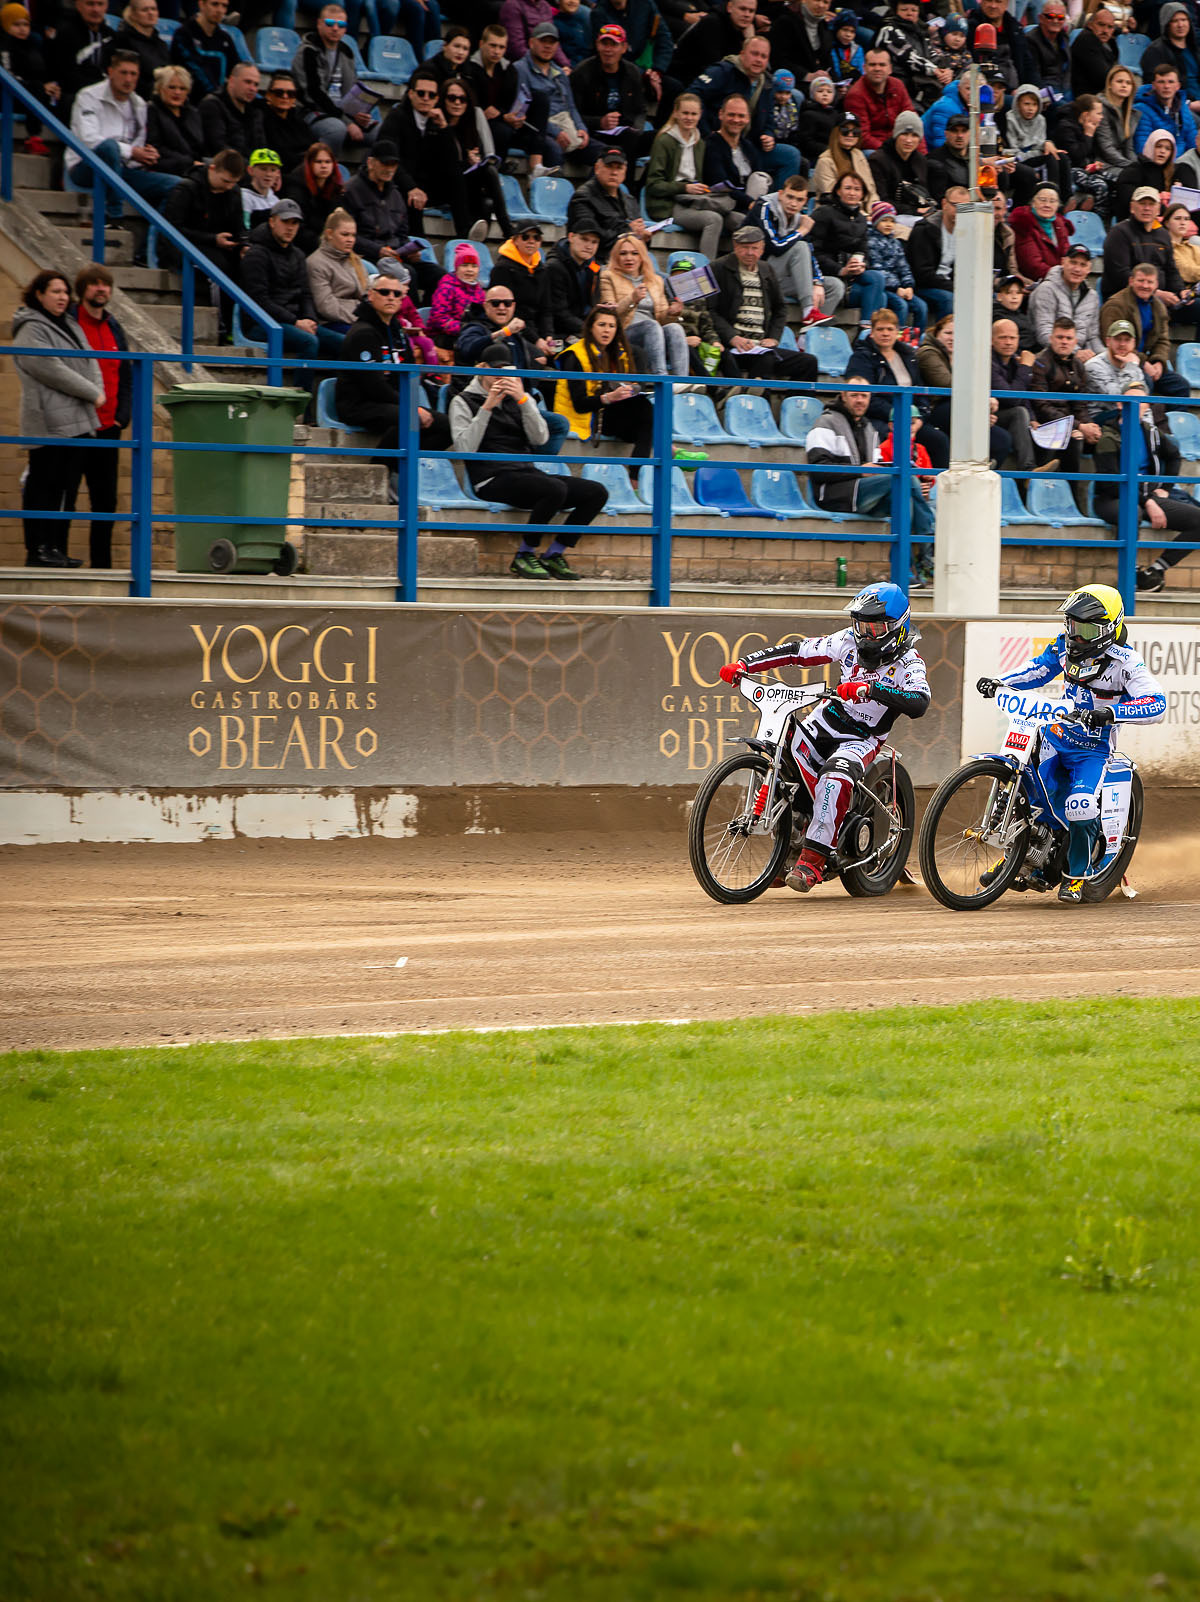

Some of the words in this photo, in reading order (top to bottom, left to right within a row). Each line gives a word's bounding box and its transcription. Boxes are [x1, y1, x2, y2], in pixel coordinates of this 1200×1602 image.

[189, 624, 379, 684] YOGGI
[190, 688, 378, 710] GASTROBĀRS
[766, 688, 806, 702] OPTIBET
[1117, 700, 1166, 716] FIGHTERS
[217, 715, 359, 770] BEAR
[1007, 732, 1029, 745] AMD
